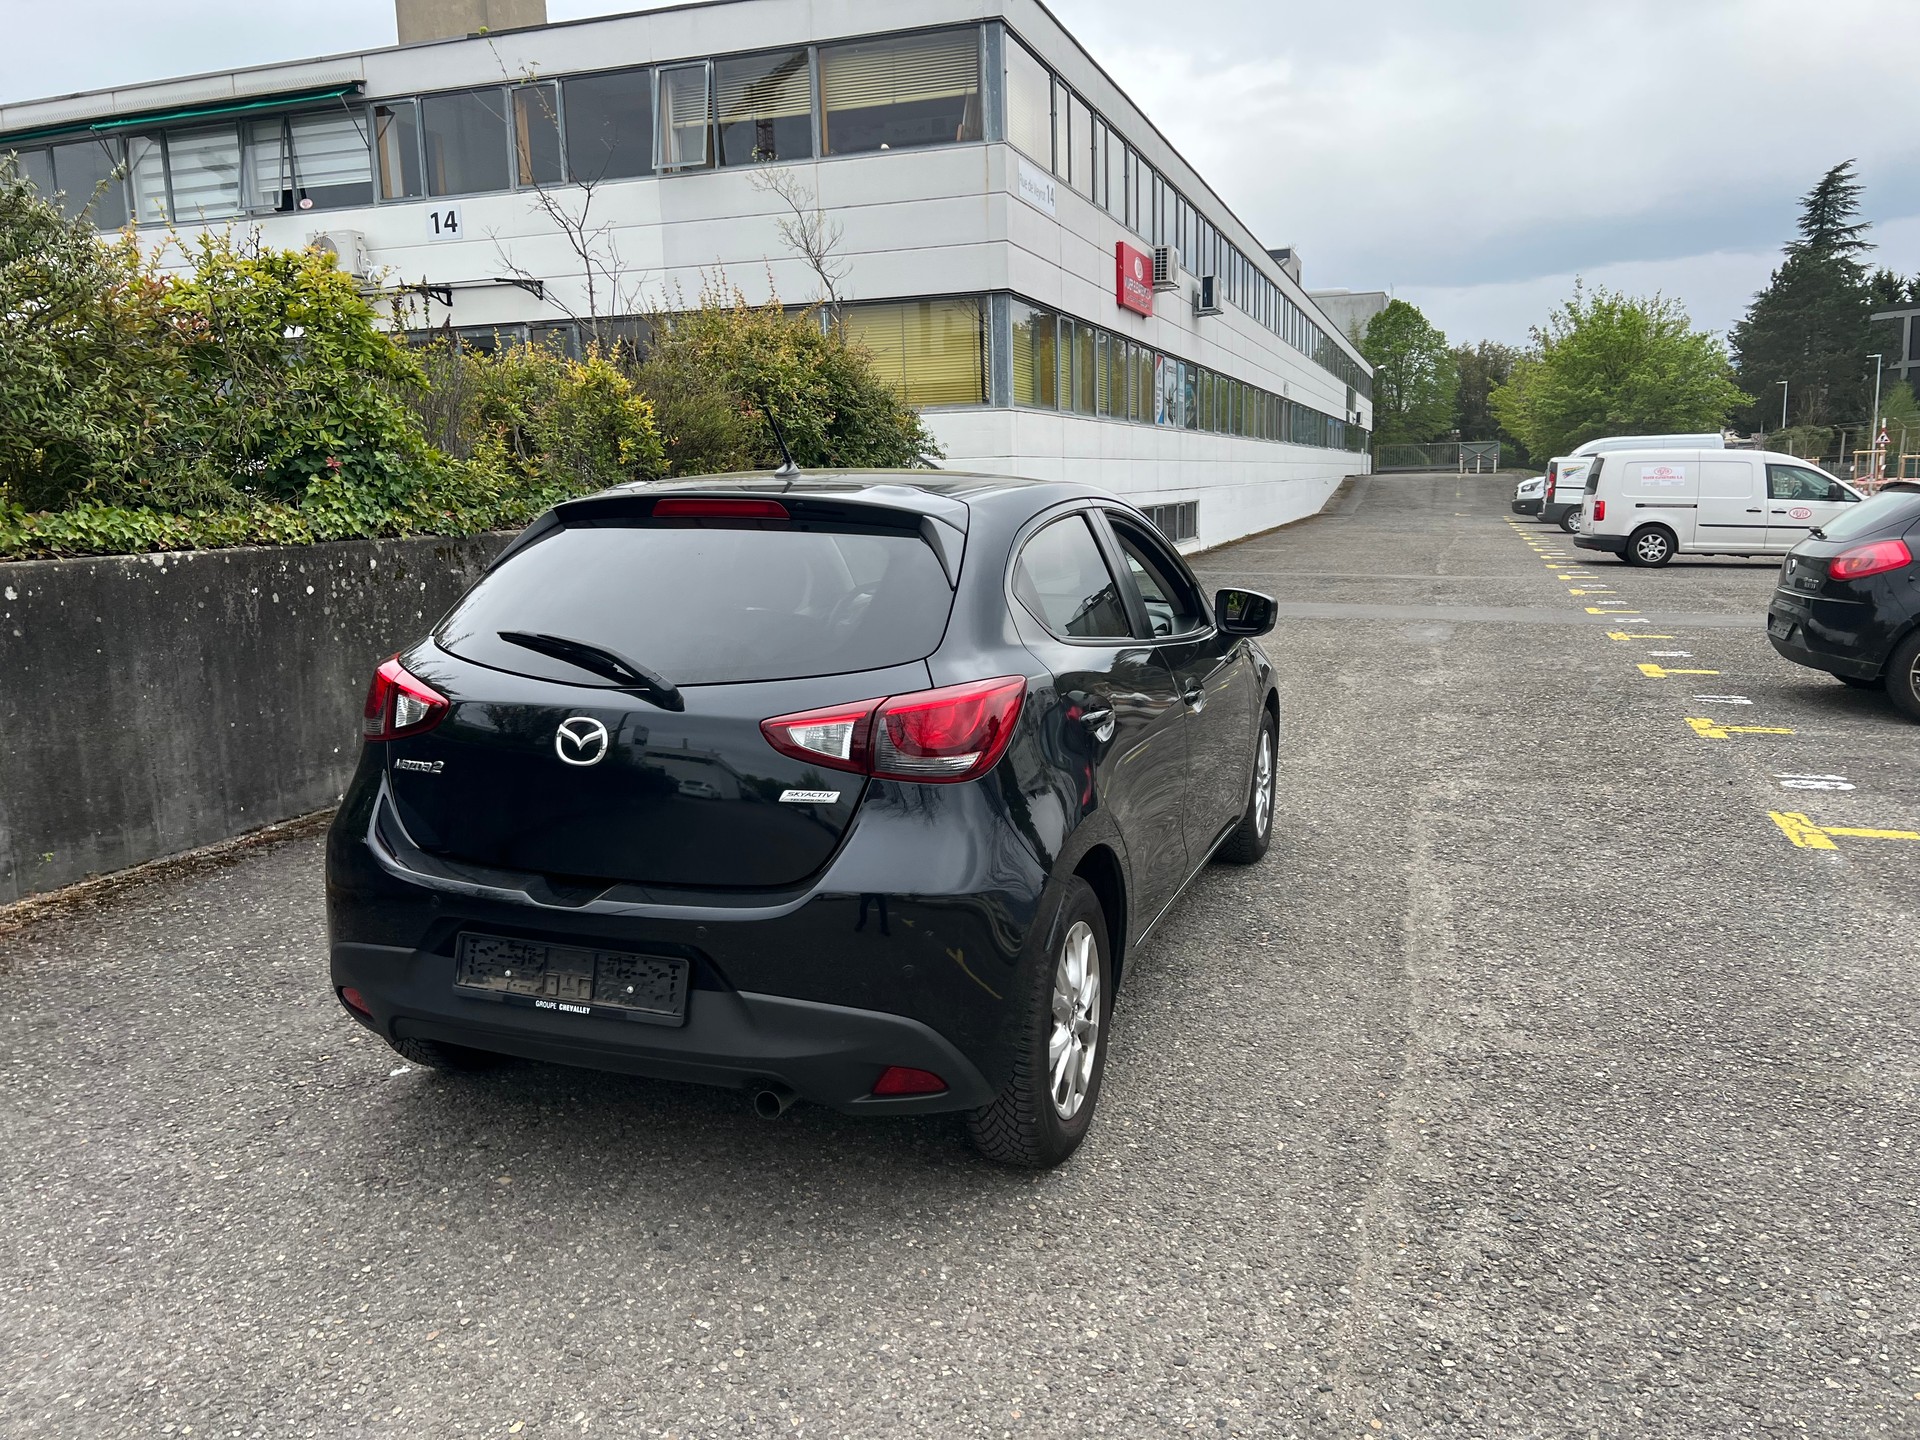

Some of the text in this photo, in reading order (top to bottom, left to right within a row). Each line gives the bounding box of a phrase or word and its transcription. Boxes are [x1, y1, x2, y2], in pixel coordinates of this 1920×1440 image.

[1046, 184, 1055, 207] 14
[430, 210, 458, 234] 14
[535, 1000, 590, 1014] GROUPE CHEVALLEY
